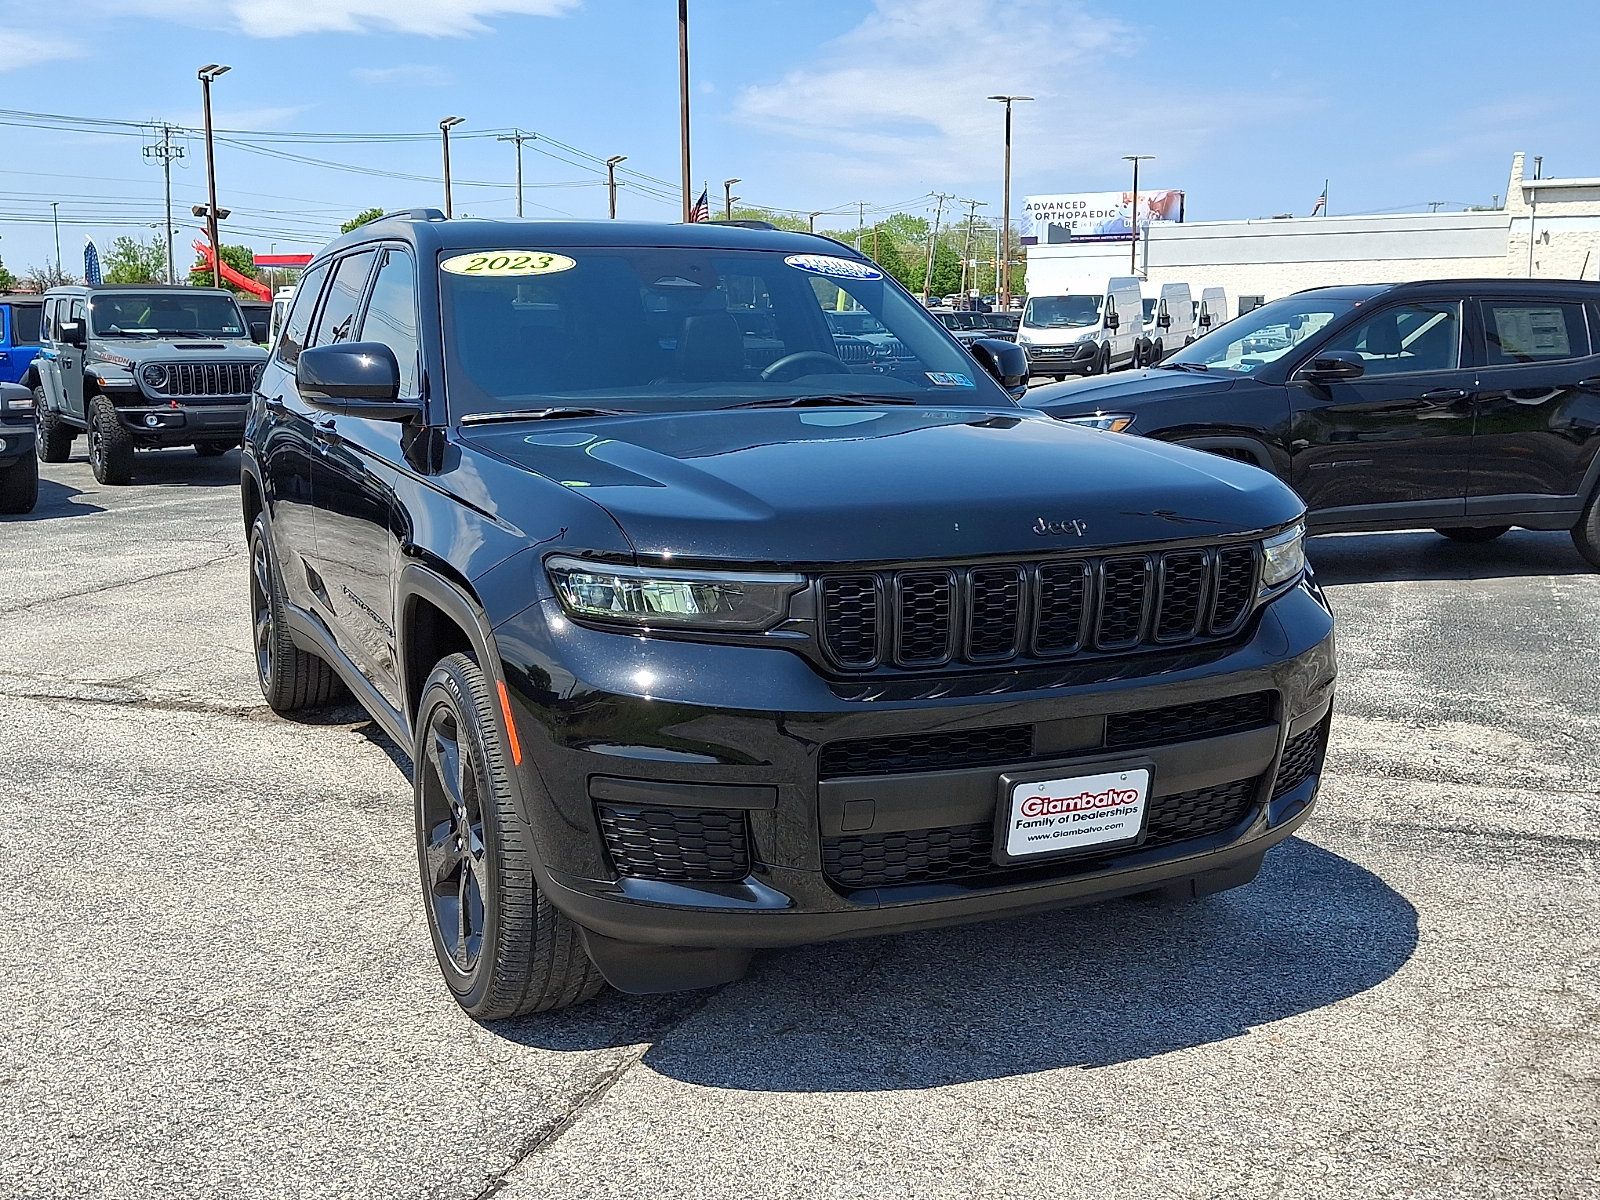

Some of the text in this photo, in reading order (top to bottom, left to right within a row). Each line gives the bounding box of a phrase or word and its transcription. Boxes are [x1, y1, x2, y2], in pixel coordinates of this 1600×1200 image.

[1025, 201, 1087, 211] ADVANCED
[1035, 209, 1116, 220] ORTHOPAEDIC
[464, 256, 553, 271] 2023
[1032, 517, 1088, 537] Jeep
[1021, 789, 1139, 817] Giambalvo
[1015, 806, 1139, 830] Family of Dealerships
[1027, 823, 1124, 841] www.Giambalvo.com
